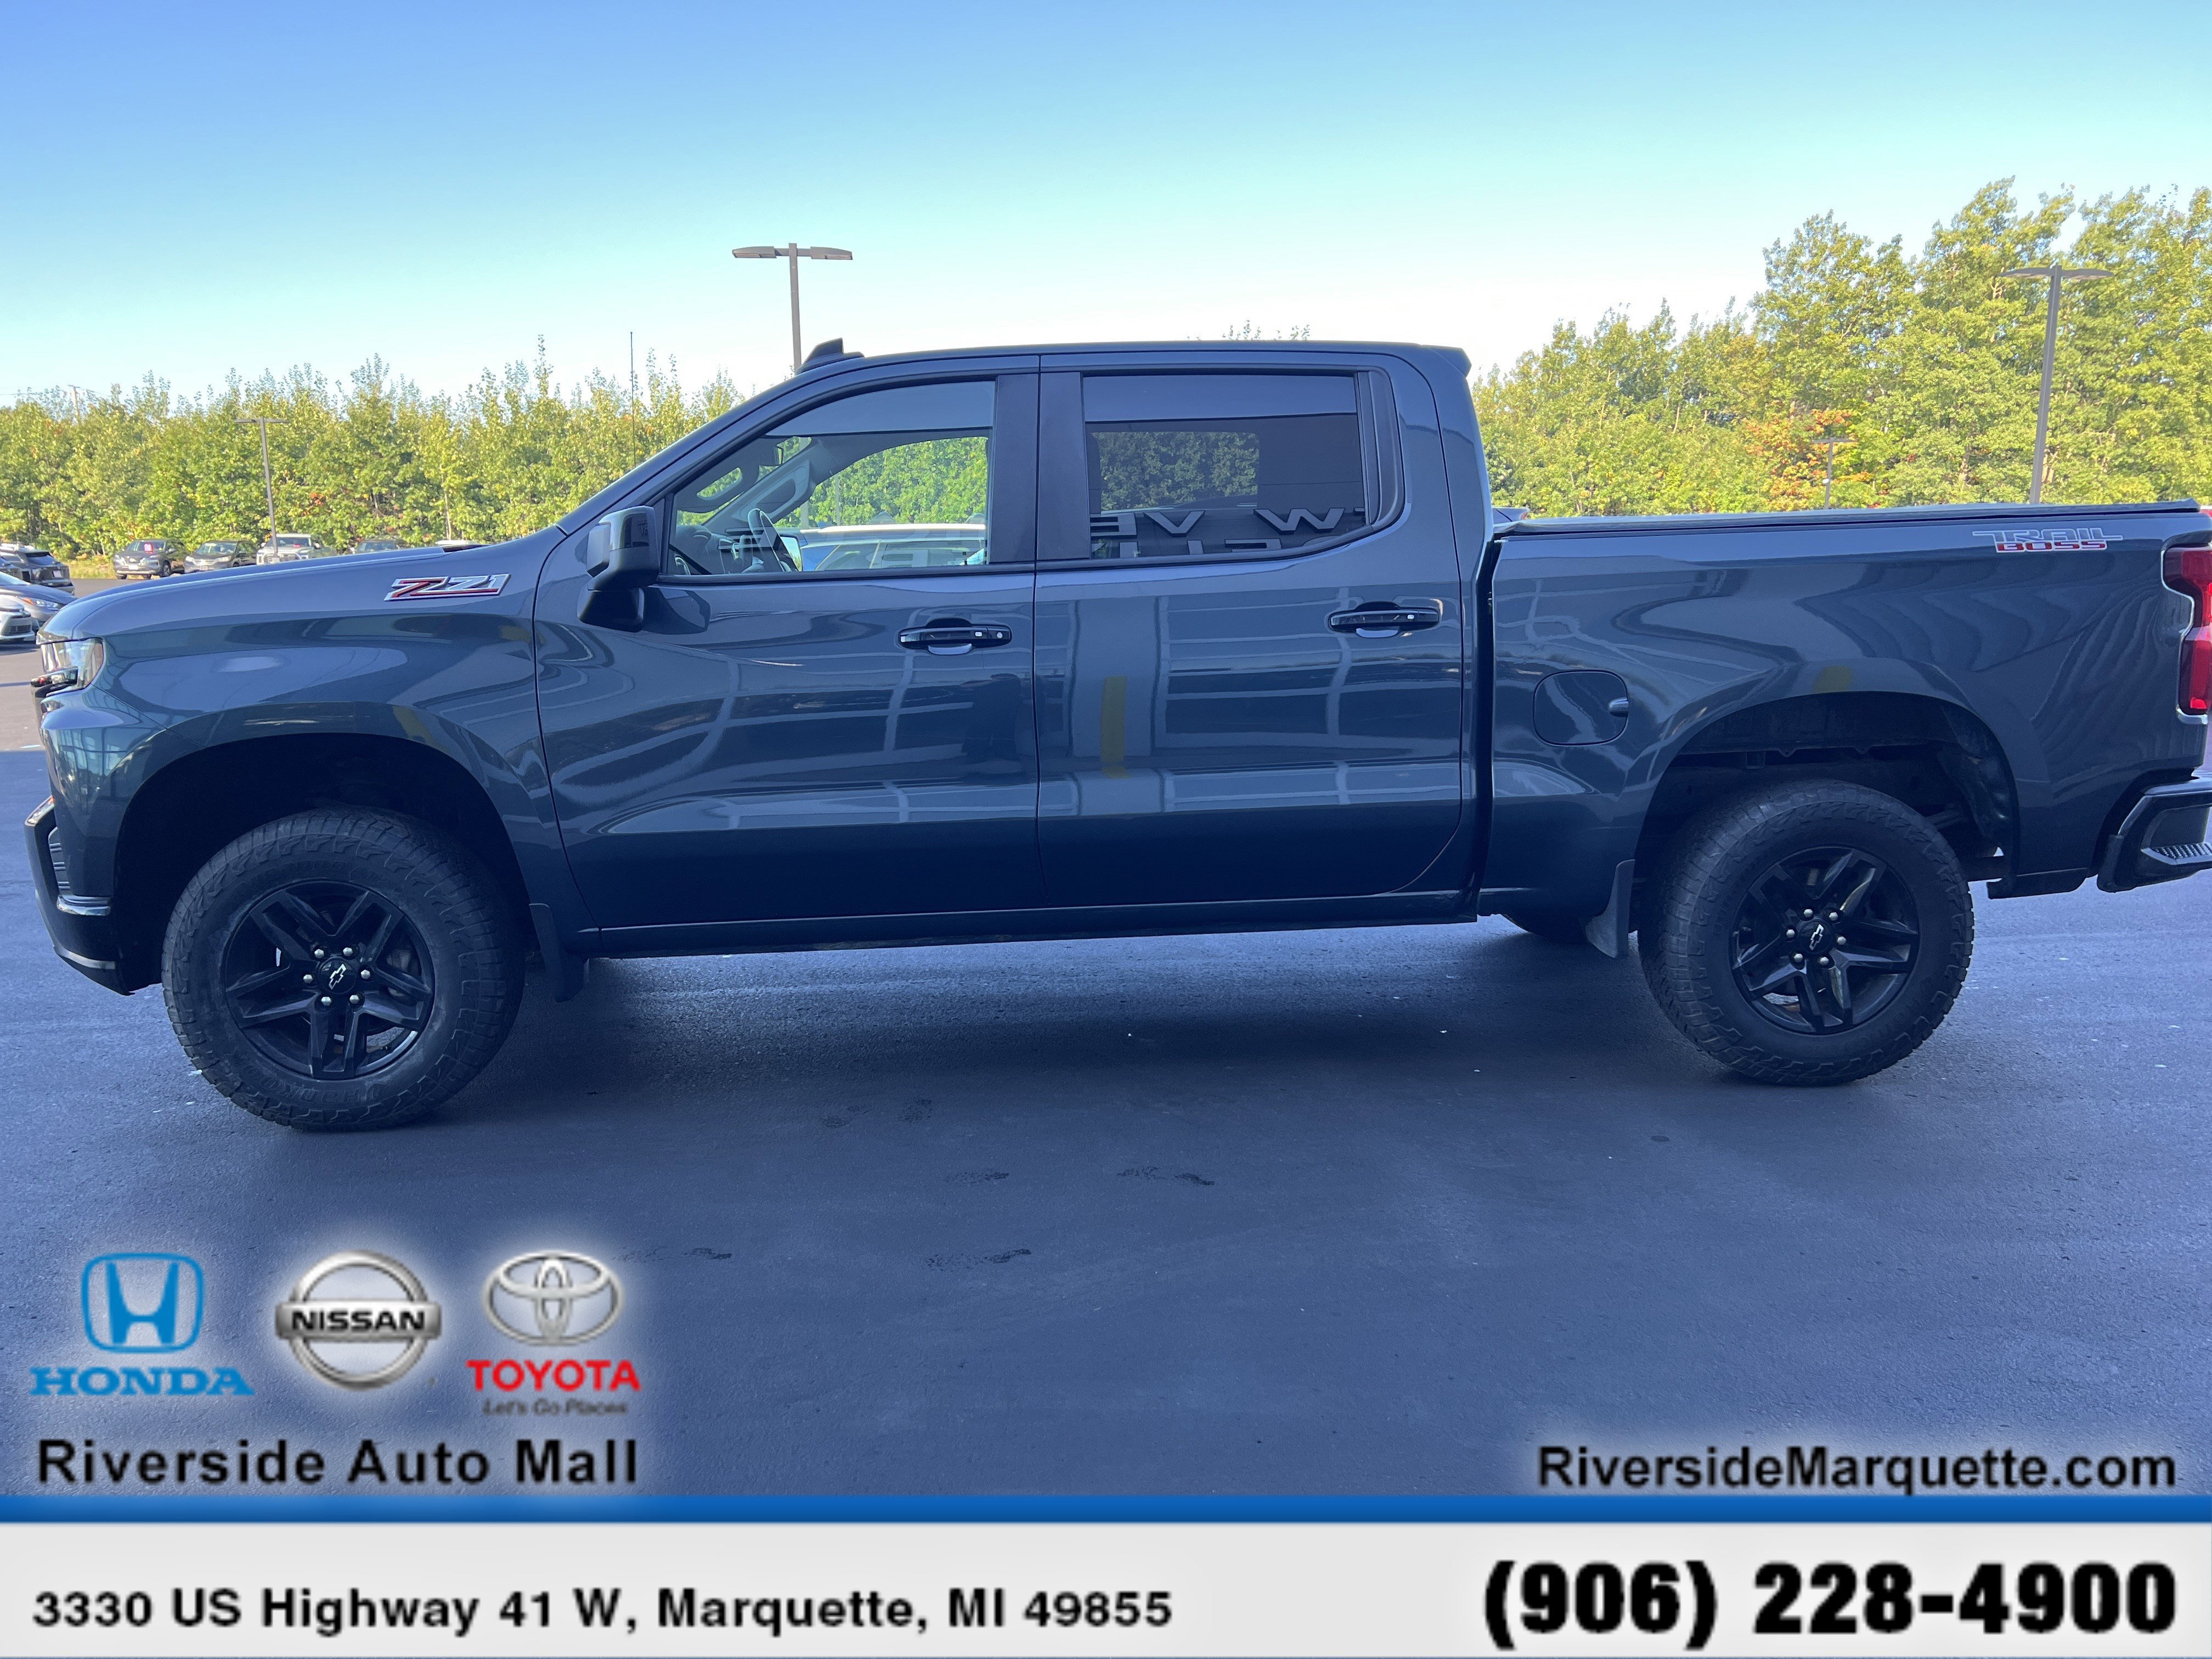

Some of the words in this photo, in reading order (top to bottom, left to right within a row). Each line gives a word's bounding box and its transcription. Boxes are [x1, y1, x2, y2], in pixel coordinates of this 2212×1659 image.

[1972, 527, 2123, 541] TRAIL
[1996, 540, 2107, 553] BOSS
[384, 573, 511, 601] Z71
